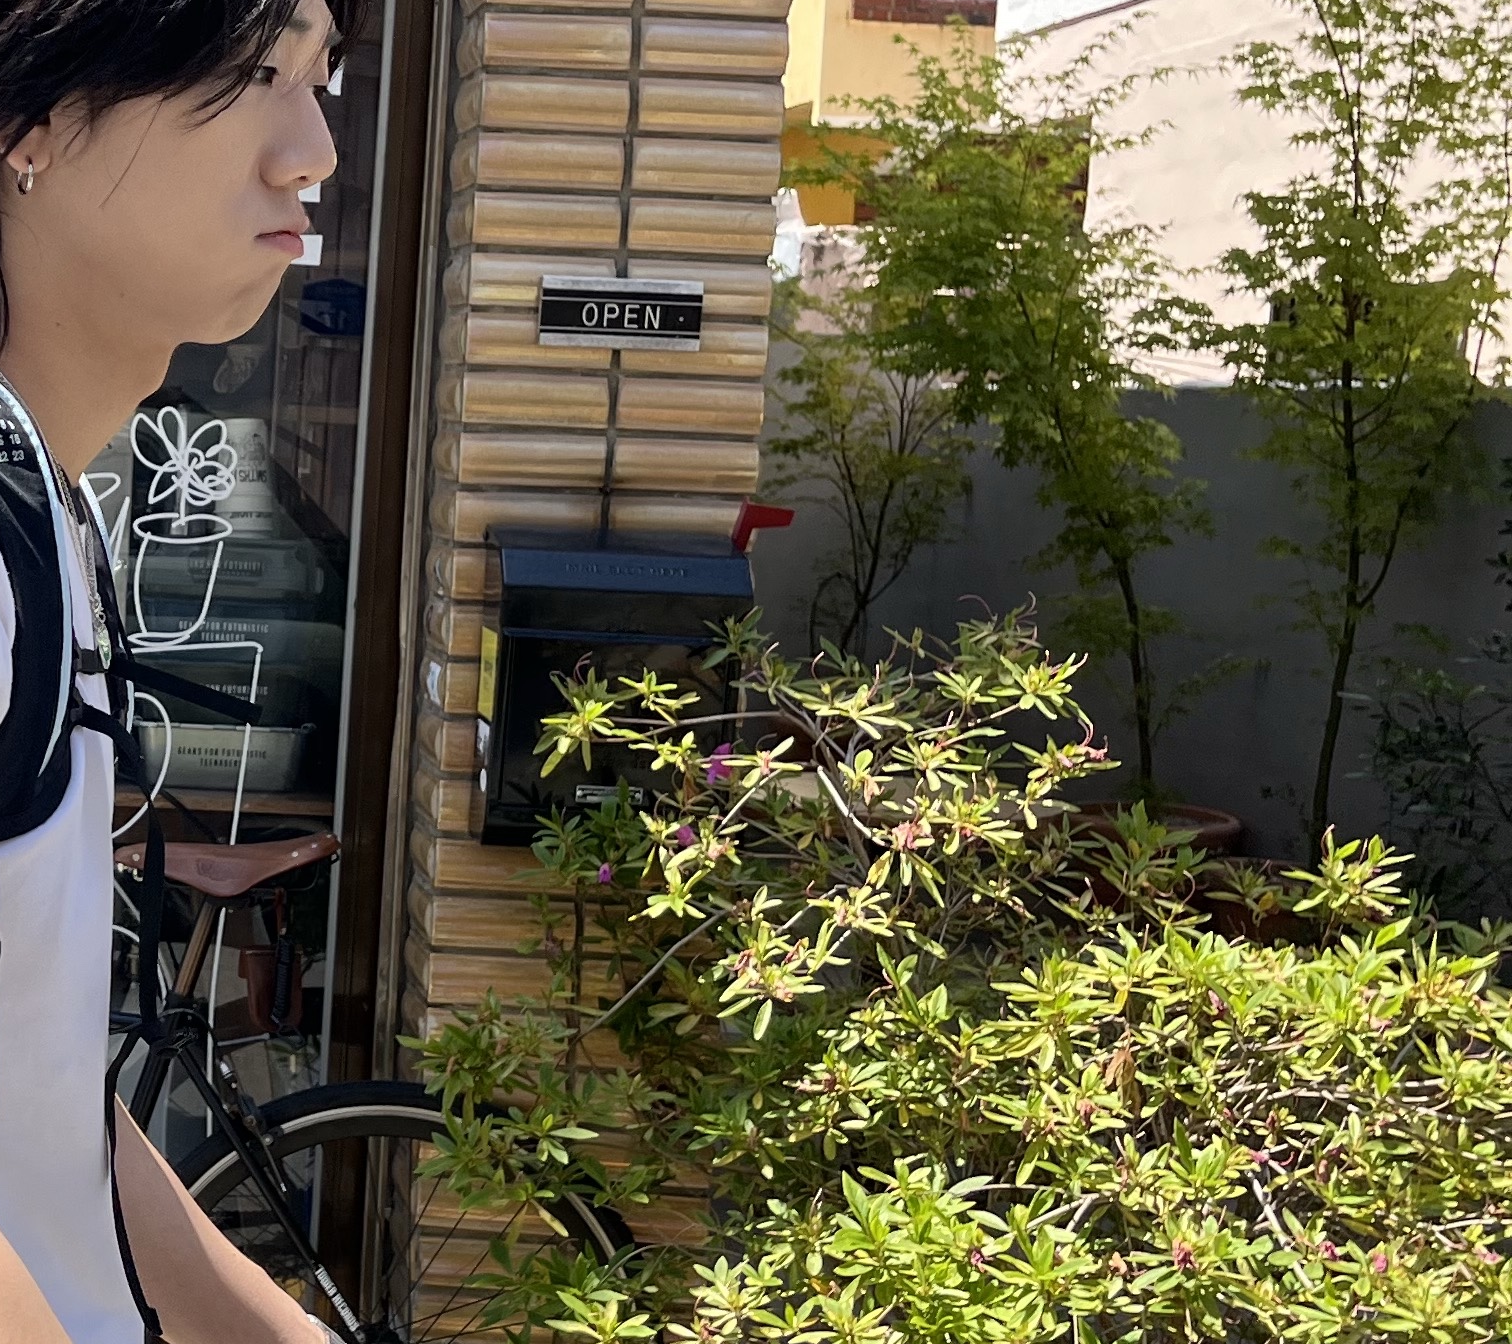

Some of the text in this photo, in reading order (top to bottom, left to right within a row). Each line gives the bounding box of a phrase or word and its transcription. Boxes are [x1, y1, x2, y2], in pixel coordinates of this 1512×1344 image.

[582, 302, 661, 330] OPEN
[12, 450, 24, 461] 23
[222, 684, 268, 695] FUTURITIC
[205, 747, 219, 755] FOR
[222, 748, 266, 759] FUTUSTIC
[200, 757, 241, 767] TEENAGER
